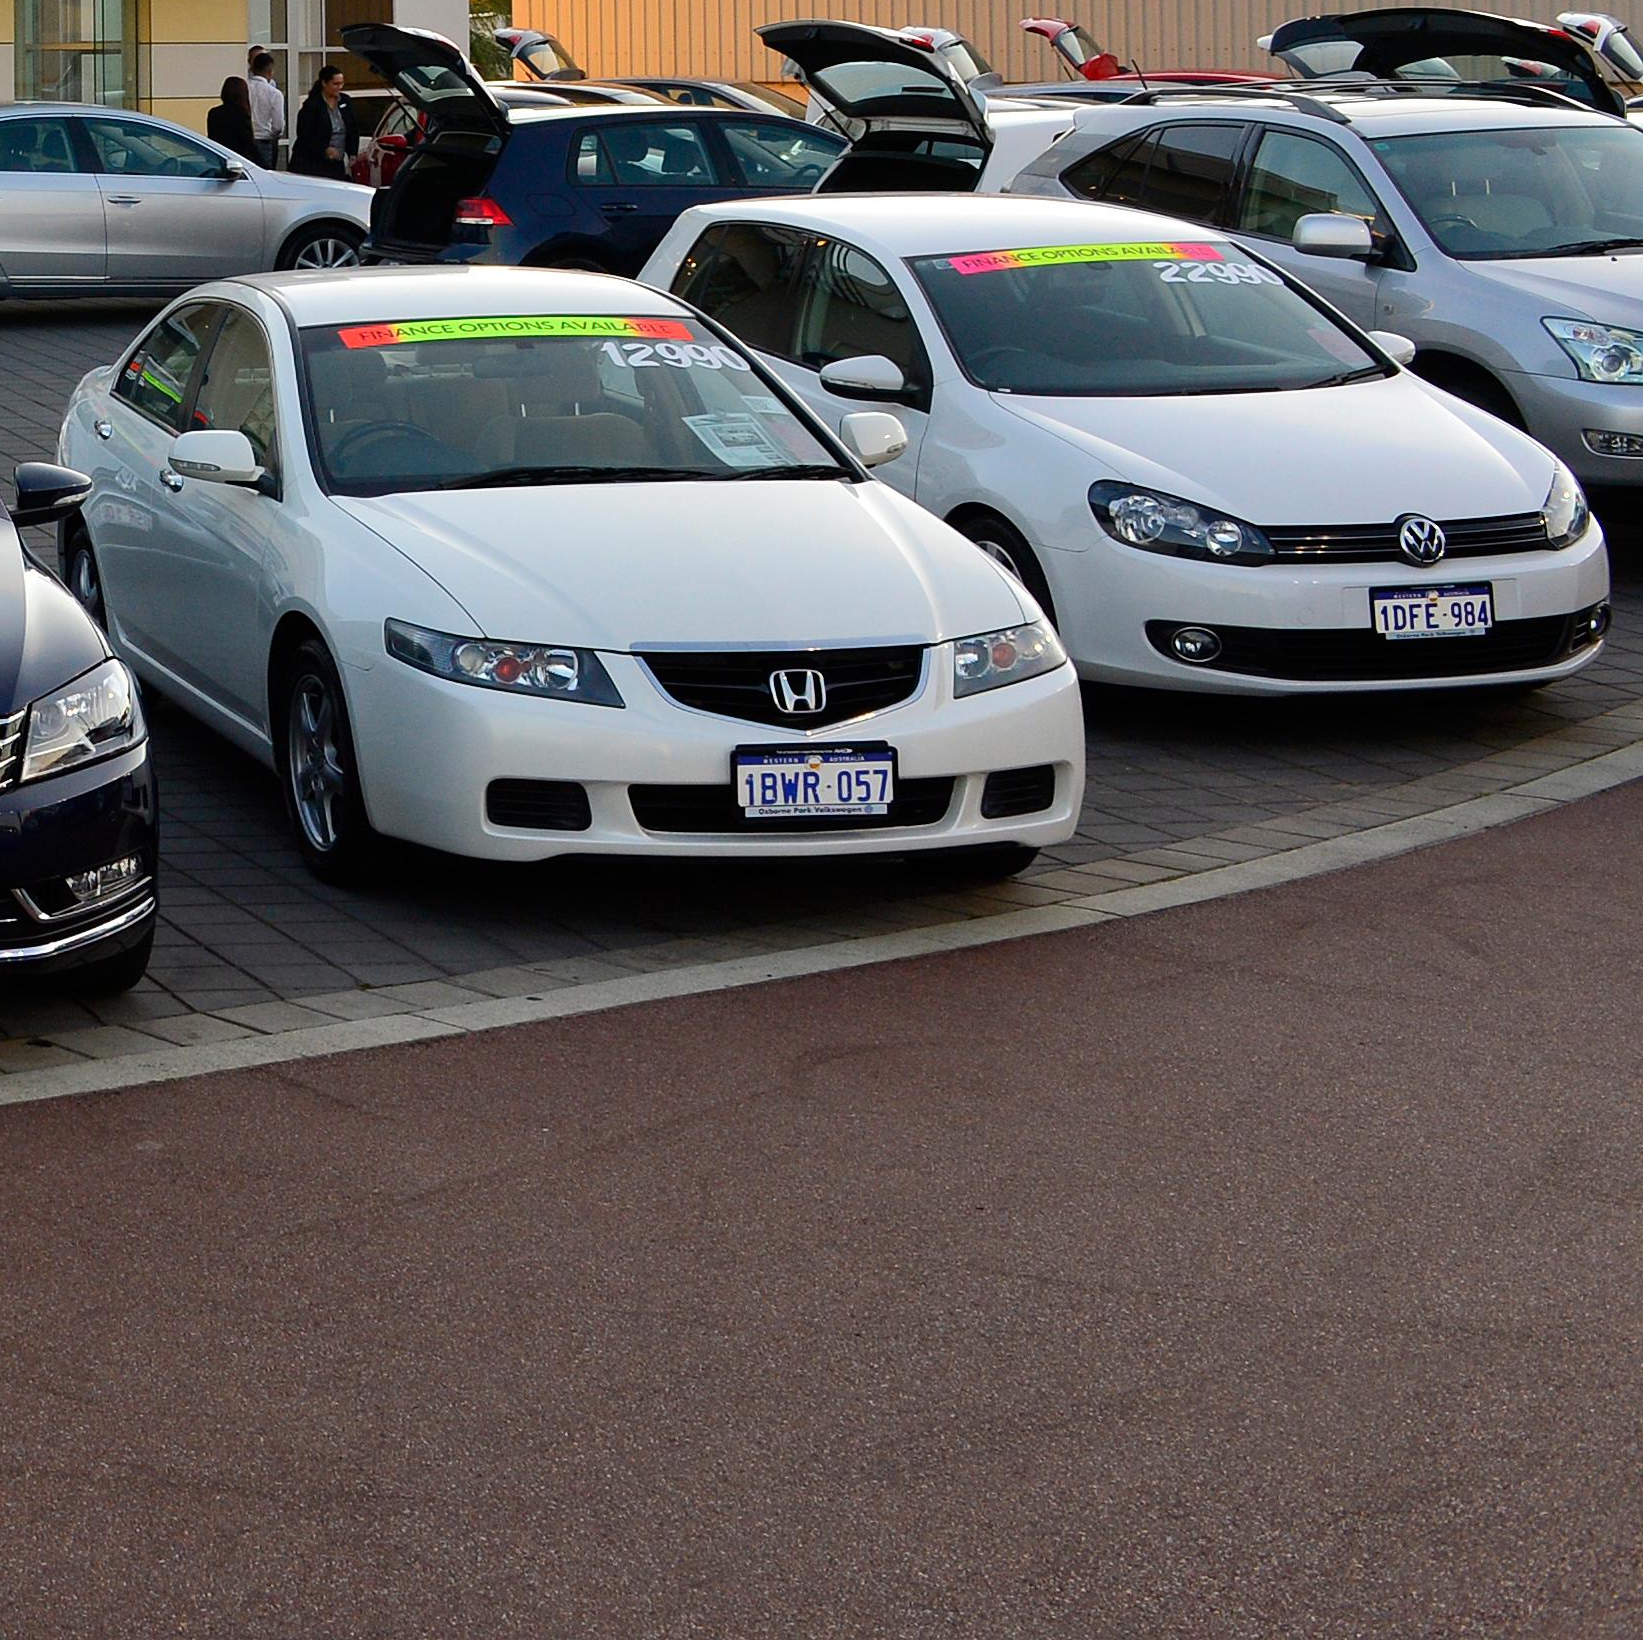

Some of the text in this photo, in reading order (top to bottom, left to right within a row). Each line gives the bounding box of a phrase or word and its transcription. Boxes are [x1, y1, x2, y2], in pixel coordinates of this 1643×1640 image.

[962, 251, 1047, 270] FINANCE
[1050, 246, 1119, 261] OPTIONS
[1153, 261, 1286, 286] 22990
[358, 318, 674, 342] FINANCE OPTIONS AVAILABLE
[600, 340, 751, 372] 12990
